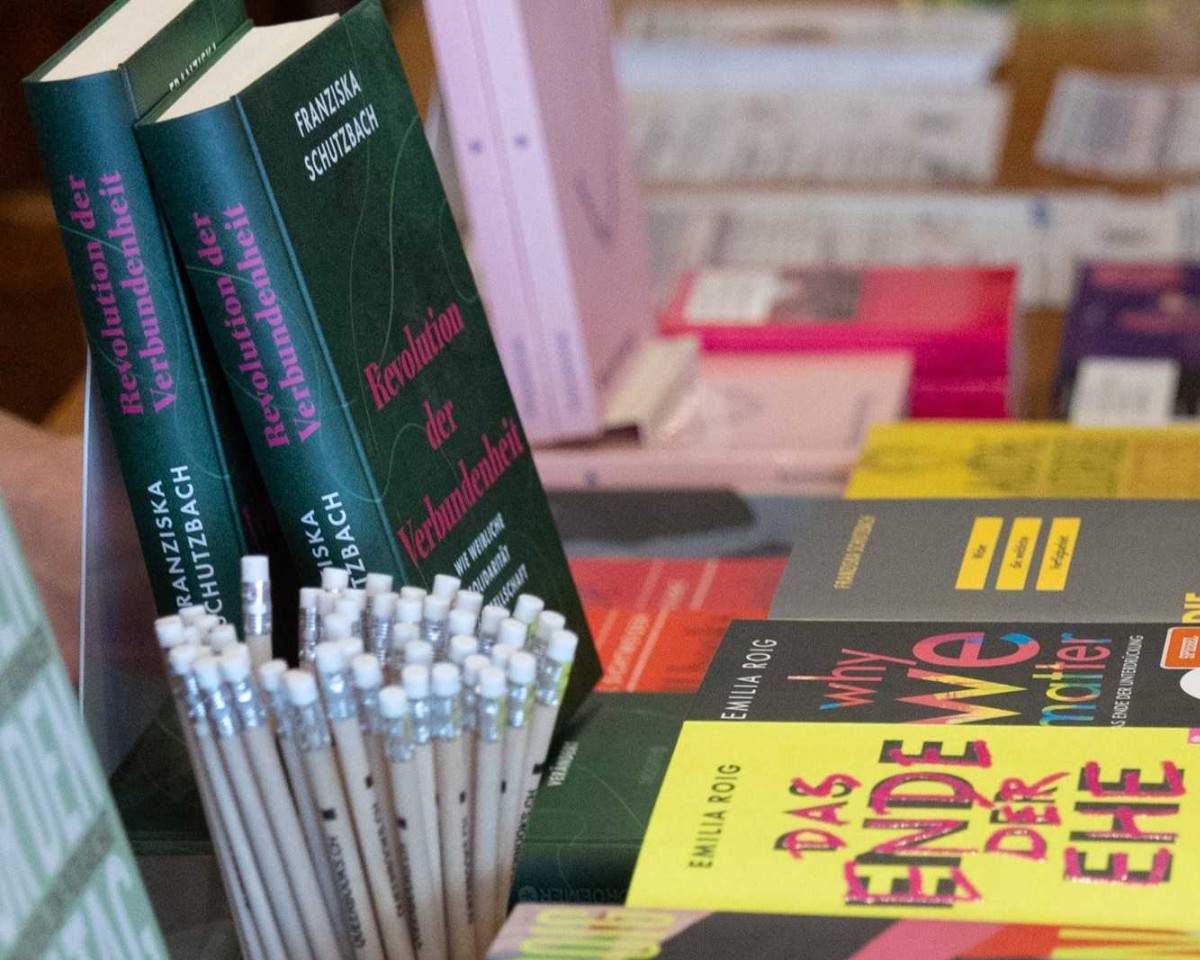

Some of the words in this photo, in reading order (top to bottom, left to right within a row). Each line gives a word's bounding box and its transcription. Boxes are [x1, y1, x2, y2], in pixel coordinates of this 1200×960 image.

[294, 70, 361, 138] FRANZISKA
[304, 104, 379, 181] SCHUTZBACH
[69, 173, 96, 230] der
[192, 212, 224, 266] der
[87, 241, 144, 416] Revolution
[99, 171, 177, 414] Verbundenheit
[224, 202, 322, 442] Verbundenheit
[217, 275, 290, 448] Revolution
[364, 301, 465, 411] Revolution
[423, 400, 457, 451] der
[398, 416, 523, 569] Verbundenheit
[147, 480, 191, 609] RANZISKA
[170, 465, 228, 625] CHUTZBACH
[721, 674, 762, 720] EMILIA
[751, 637, 777, 672] ROIG
[787, 648, 918, 710] why
[1032, 632, 1112, 726] matter
[1116, 686, 1133, 700] DER
[1119, 635, 1144, 686] UNTERDRÜCKUNG
[1112, 700, 1131, 720] ENDE
[688, 808, 729, 868] EMILIA
[712, 763, 741, 806] ROIG
[774, 772, 861, 860] DAS
[843, 739, 993, 908] ENDE
[984, 771, 1071, 863] DER
[1062, 761, 1187, 887] EHE
